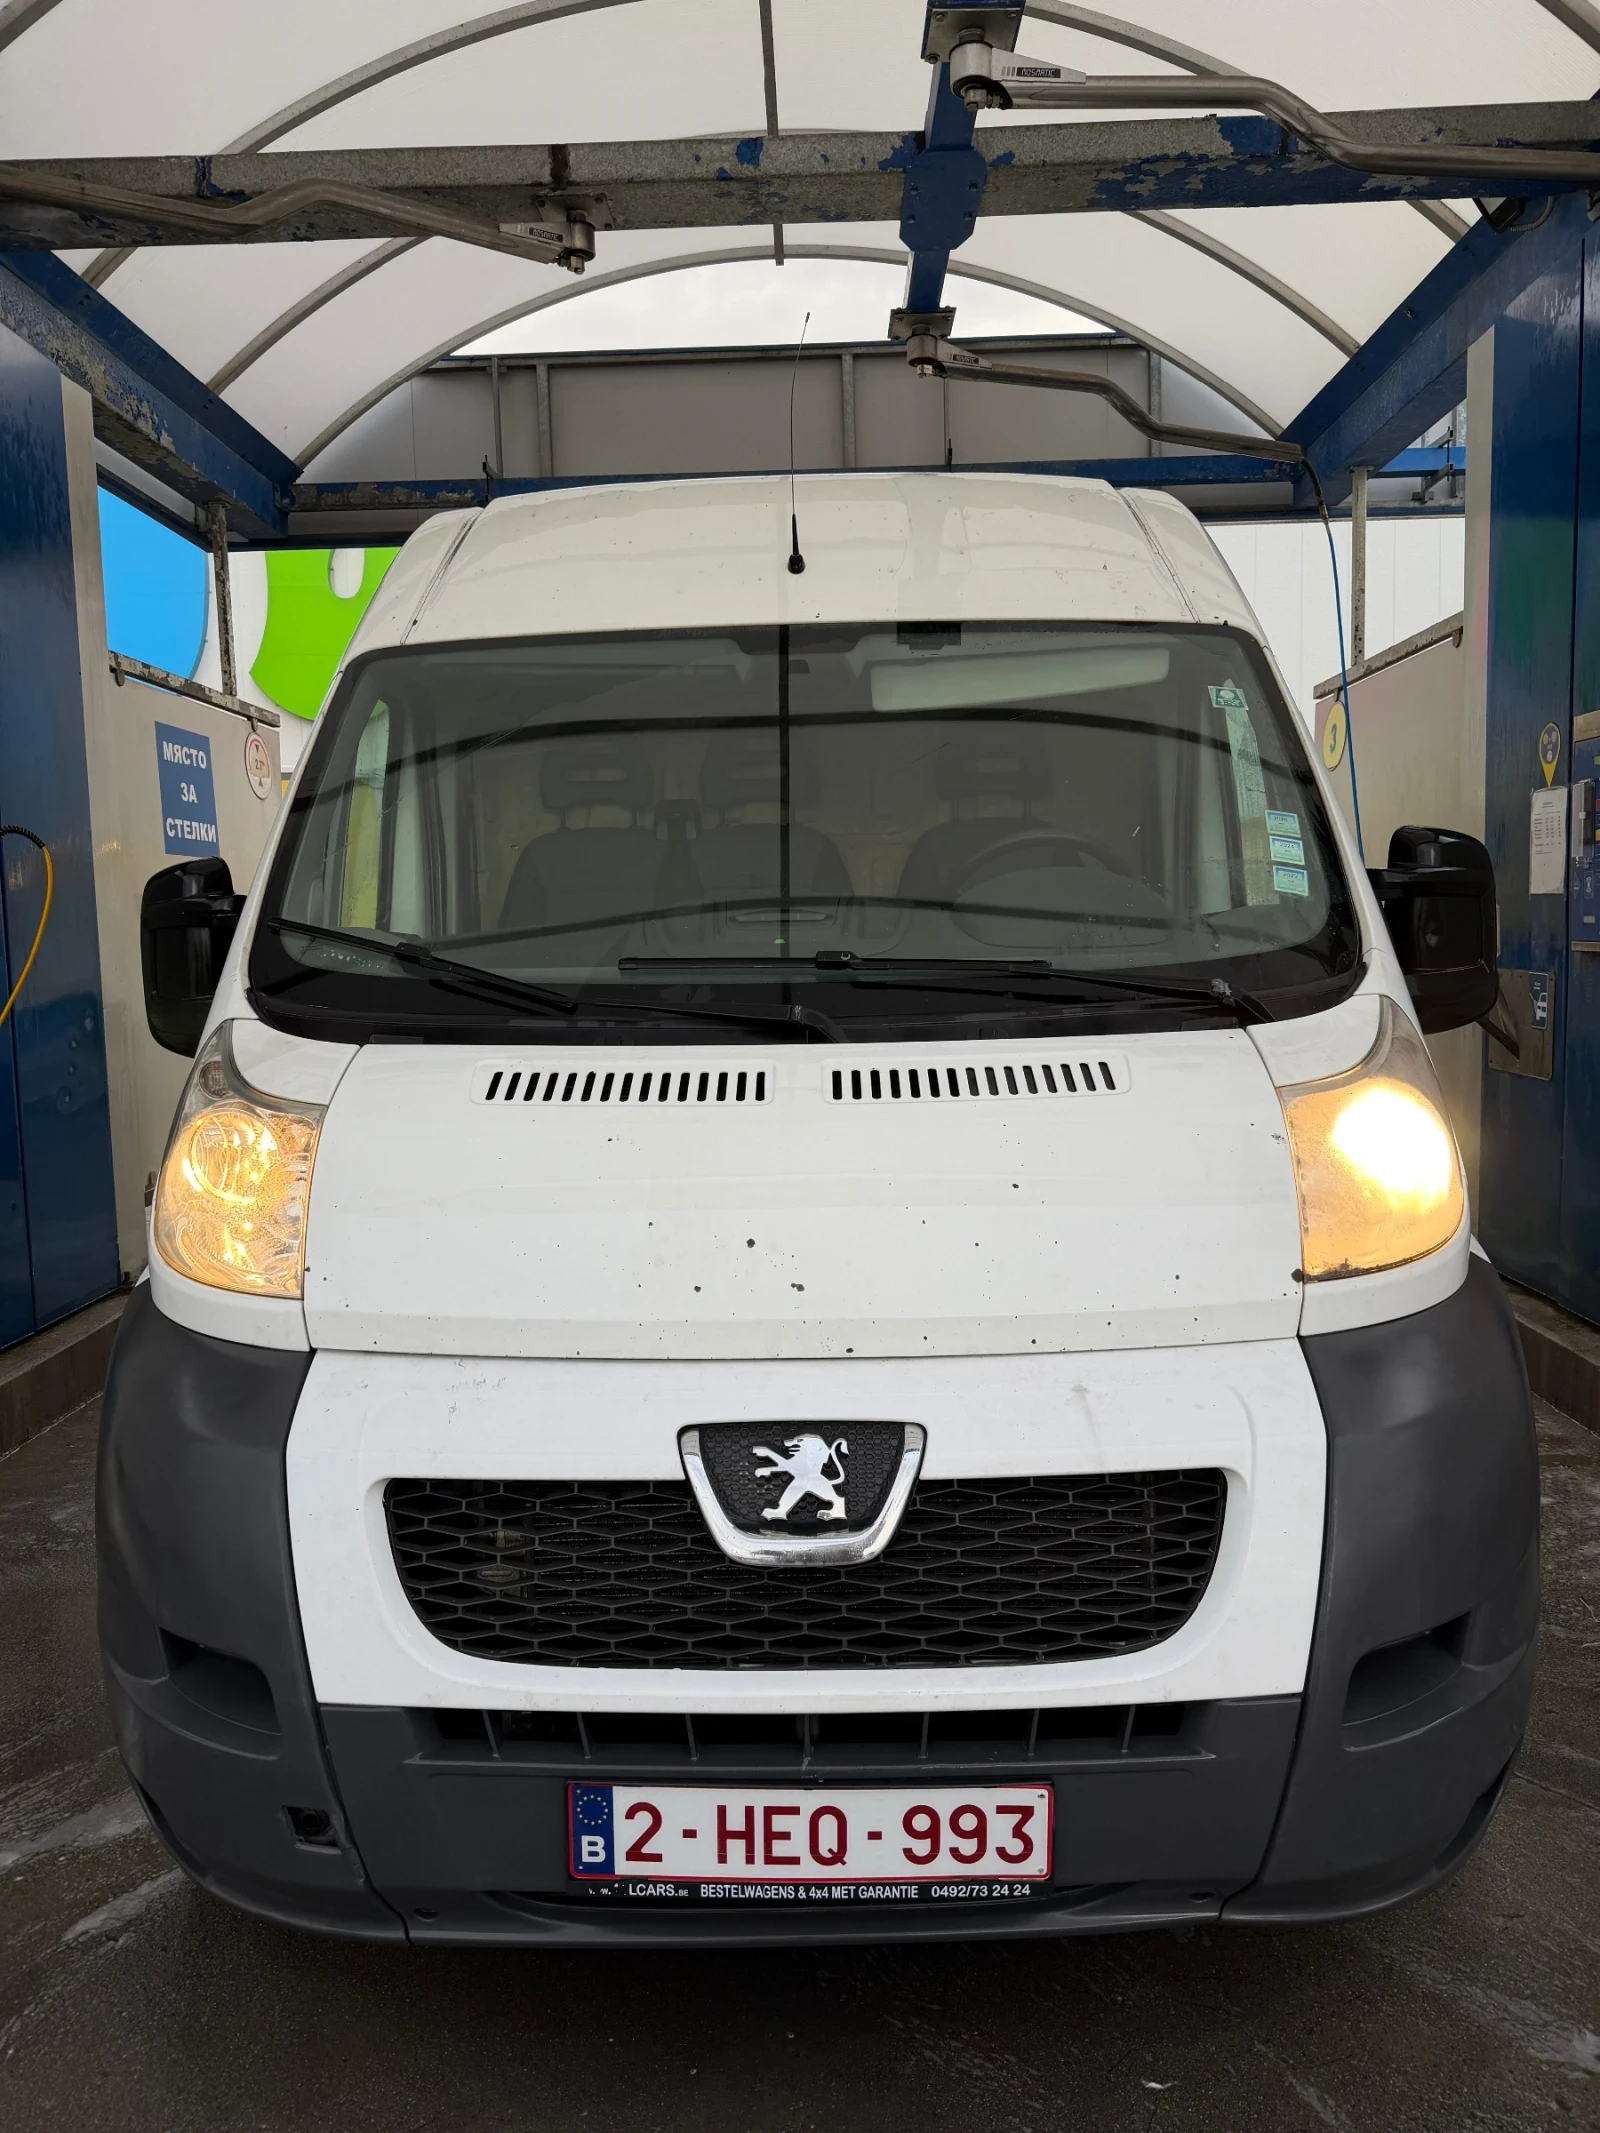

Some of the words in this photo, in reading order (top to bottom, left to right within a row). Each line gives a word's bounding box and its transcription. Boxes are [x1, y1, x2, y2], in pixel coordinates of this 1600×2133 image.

[1329, 723, 1337, 753] 3
[162, 740, 207, 770] МЯСТО
[180, 782, 198, 804] ЗА
[165, 816, 217, 843] СТЕЛКИ
[624, 1801, 1036, 1866] 2-HEQ-993
[581, 1834, 607, 1863] B
[700, 1884, 795, 1899] BESTELWAGENS
[797, 1885, 807, 1899] &
[808, 1886, 829, 1899] 4x4
[831, 1885, 857, 1899] MET
[858, 1885, 919, 1899] GARANTIE
[931, 1885, 989, 1898] 0492/73
[992, 1884, 1009, 1897] 24
[1013, 1884, 1031, 1896] 24
